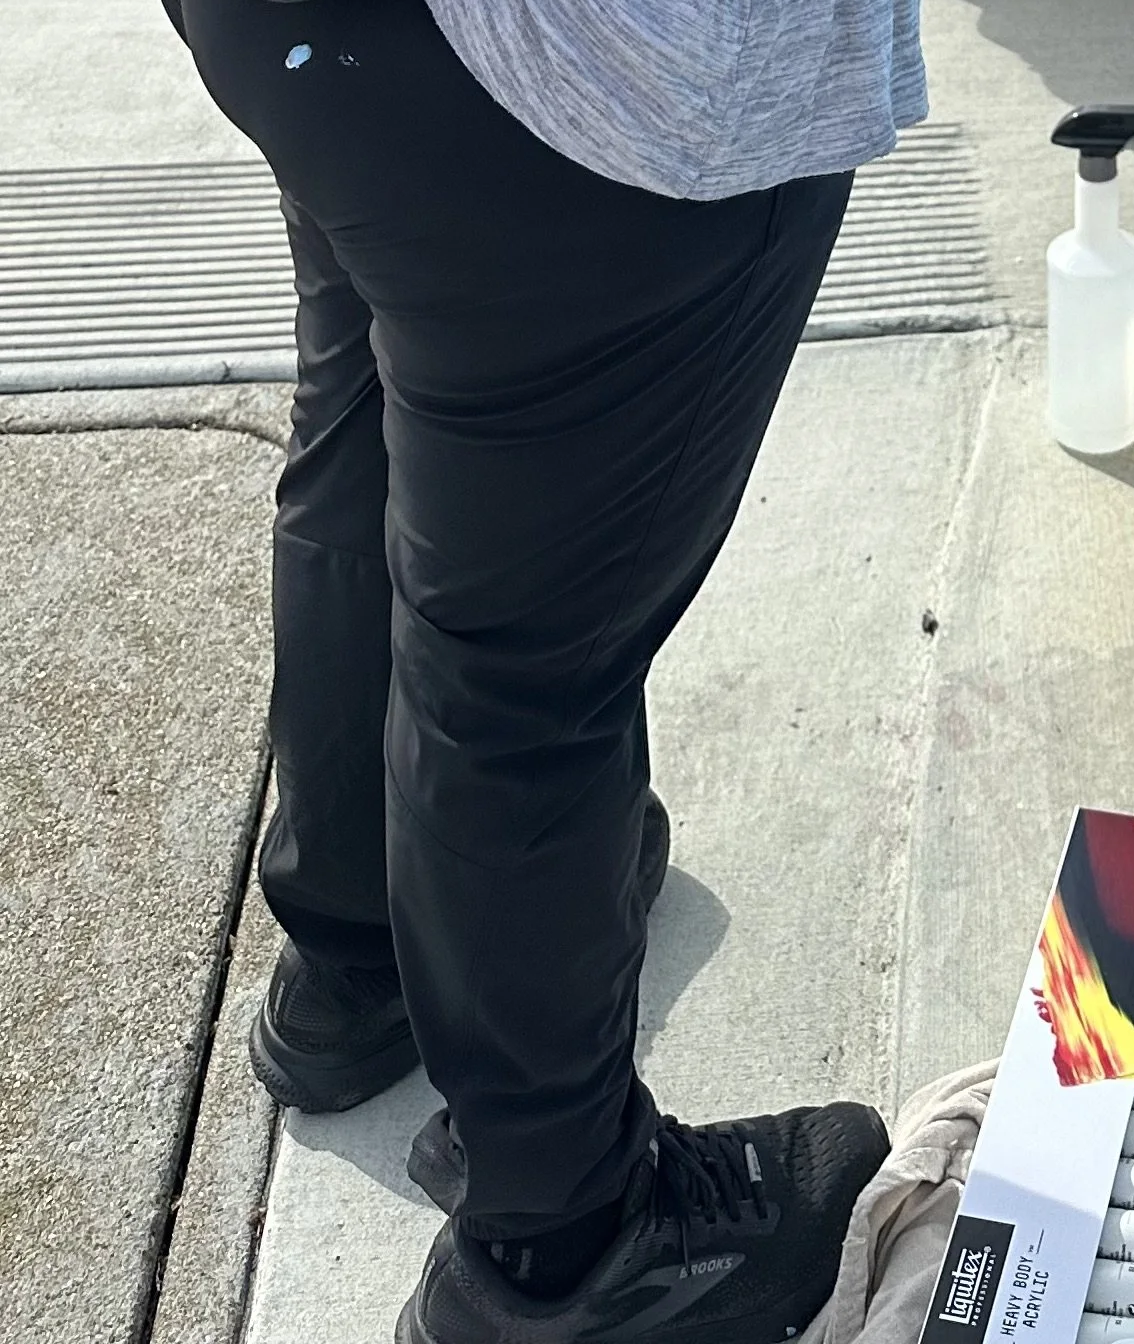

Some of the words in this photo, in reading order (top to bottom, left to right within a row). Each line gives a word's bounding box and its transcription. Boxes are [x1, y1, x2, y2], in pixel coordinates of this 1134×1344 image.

[679, 1257, 734, 1280] BROOKS
[938, 1248, 988, 1325] Liquitex
[970, 1253, 997, 1327] PROFESSIONAL
[1000, 1294, 1024, 1336] HEAVY
[1023, 1270, 1050, 1329] ACRYLIC
